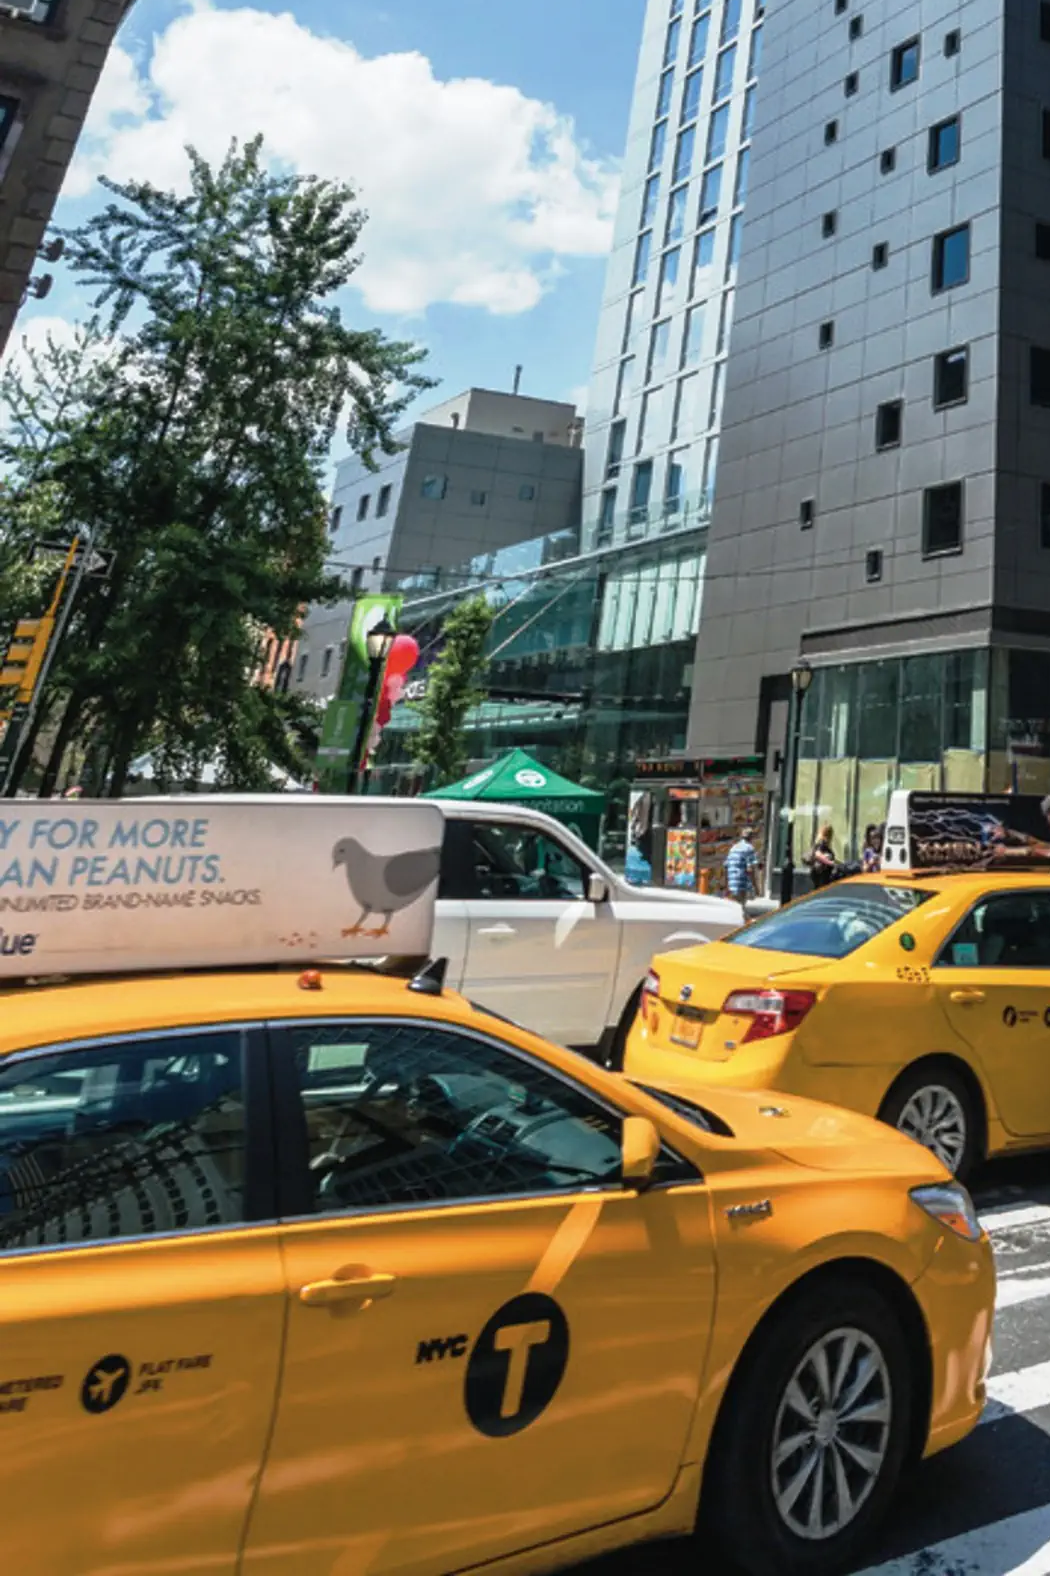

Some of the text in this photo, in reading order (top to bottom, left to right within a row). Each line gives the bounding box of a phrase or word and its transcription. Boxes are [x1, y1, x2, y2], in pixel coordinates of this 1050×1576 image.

[28, 818, 99, 850] FOR
[108, 818, 209, 849] MORE
[0, 854, 226, 888] AN PEANUTS.
[415, 1318, 552, 1420] NYC T
